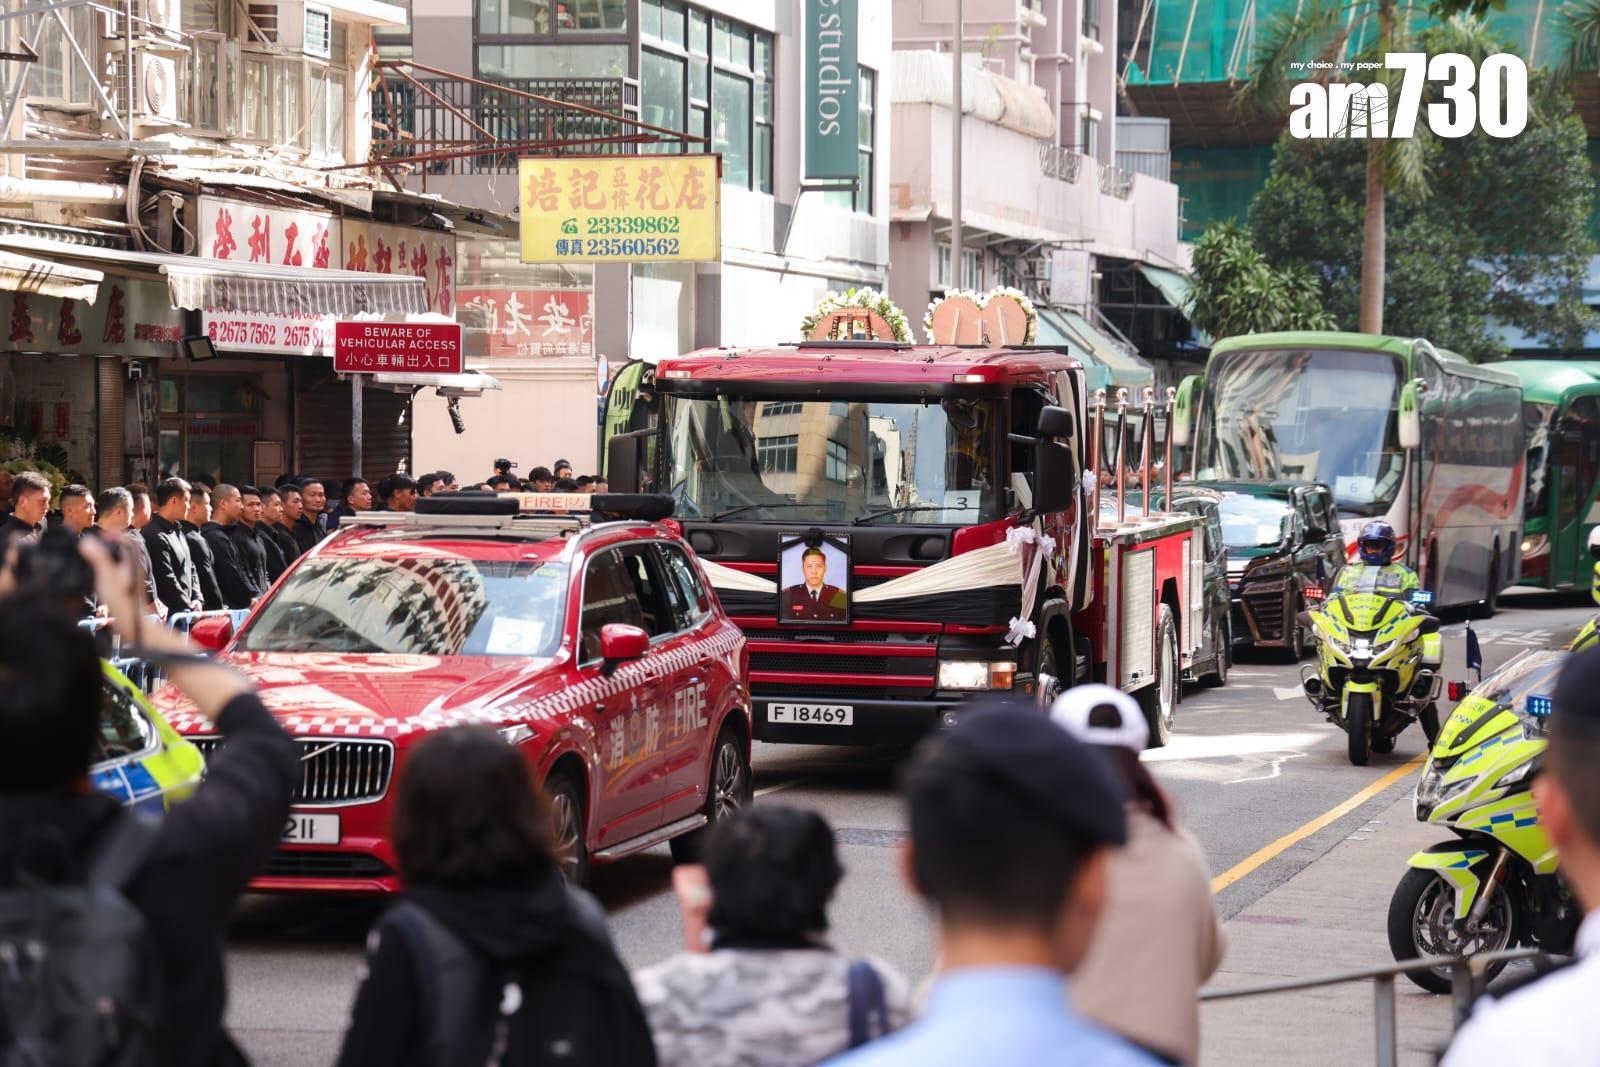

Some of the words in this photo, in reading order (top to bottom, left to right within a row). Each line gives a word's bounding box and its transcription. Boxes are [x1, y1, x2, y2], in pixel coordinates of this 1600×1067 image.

[818, 13, 852, 136] studios
[587, 216, 680, 234] 23339862
[555, 239, 584, 256] 傳真
[587, 238, 680, 256] 23560562
[219, 321, 247, 343] 2675
[249, 322, 276, 345] 7562
[283, 326, 310, 347] 2675
[364, 327, 413, 338] BEWARE
[416, 328, 432, 338] OF
[340, 338, 406, 349] VEHICULAR
[409, 339, 456, 350] ACCESS
[345, 352, 450, 368] 小心車輛出入口
[524, 496, 562, 508] FIRE
[956, 497, 968, 511] 3
[674, 682, 708, 737] FIRE
[774, 706, 785, 720] F
[793, 707, 847, 723] 18469
